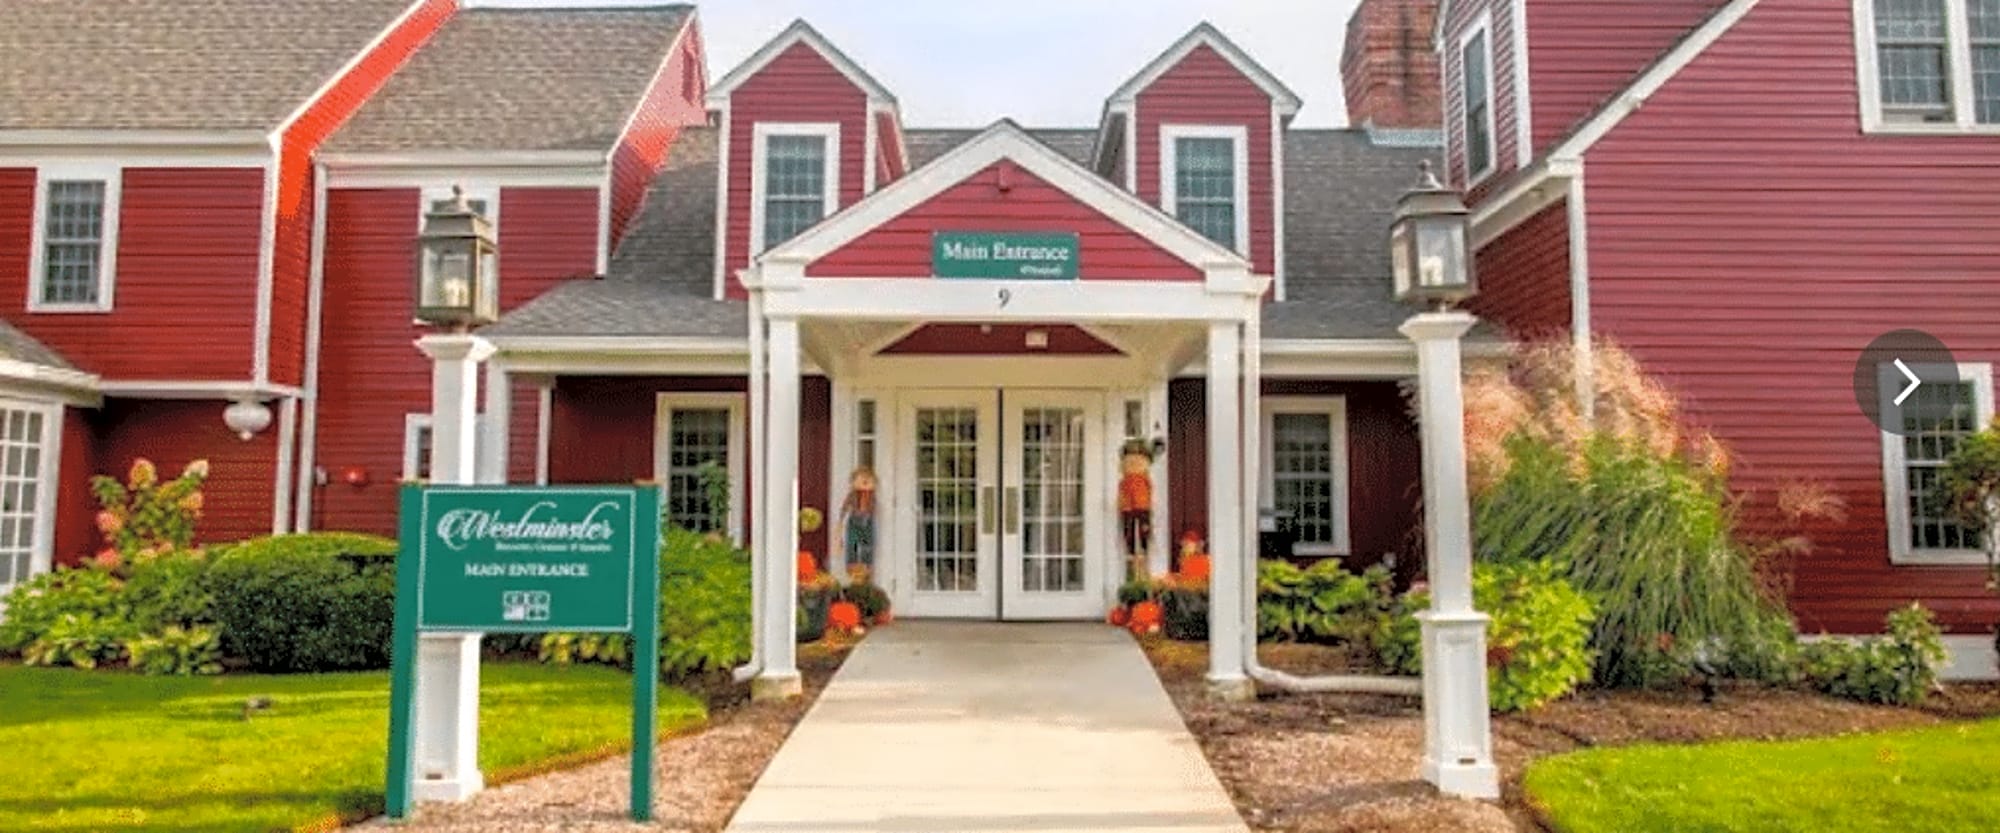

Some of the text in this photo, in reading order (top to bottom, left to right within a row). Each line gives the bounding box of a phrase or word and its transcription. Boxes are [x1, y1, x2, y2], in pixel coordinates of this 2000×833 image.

[943, 242, 1069, 261] Main Entrance
[998, 288, 1011, 309] 9
[436, 501, 620, 551] Westminster
[465, 563, 589, 577] MAIN ENTRANCE
